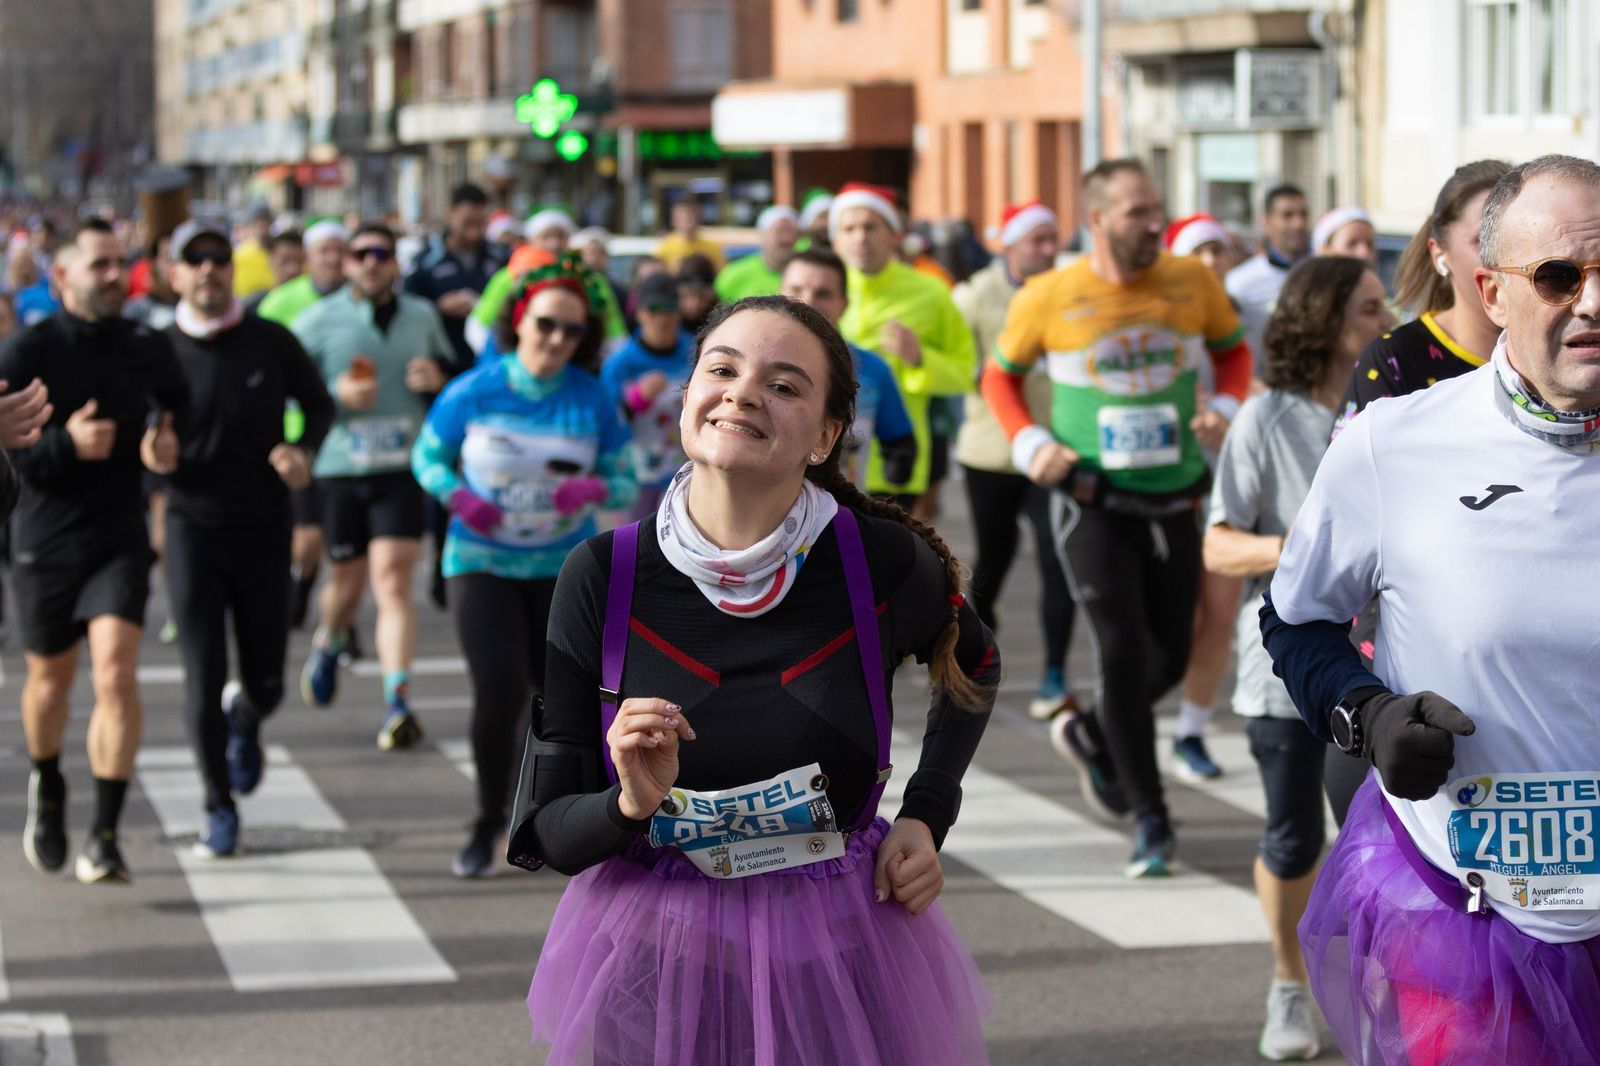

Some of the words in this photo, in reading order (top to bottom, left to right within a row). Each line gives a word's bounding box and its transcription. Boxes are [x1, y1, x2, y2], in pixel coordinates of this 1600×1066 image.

[691, 780, 806, 816] SETEL
[1495, 779, 1600, 803] SETE
[821, 802, 832, 820] 2249
[1470, 809, 1594, 865] 2608
[733, 846, 785, 862] Ayuntamiento
[736, 864, 748, 873] de
[747, 857, 787, 871] Salamanca
[1490, 861, 1533, 876] MIGUEL
[1541, 862, 1580, 875] ÁNGEL
[1532, 886, 1584, 896] Ayuntamiento
[1543, 897, 1584, 906] Salamanca
